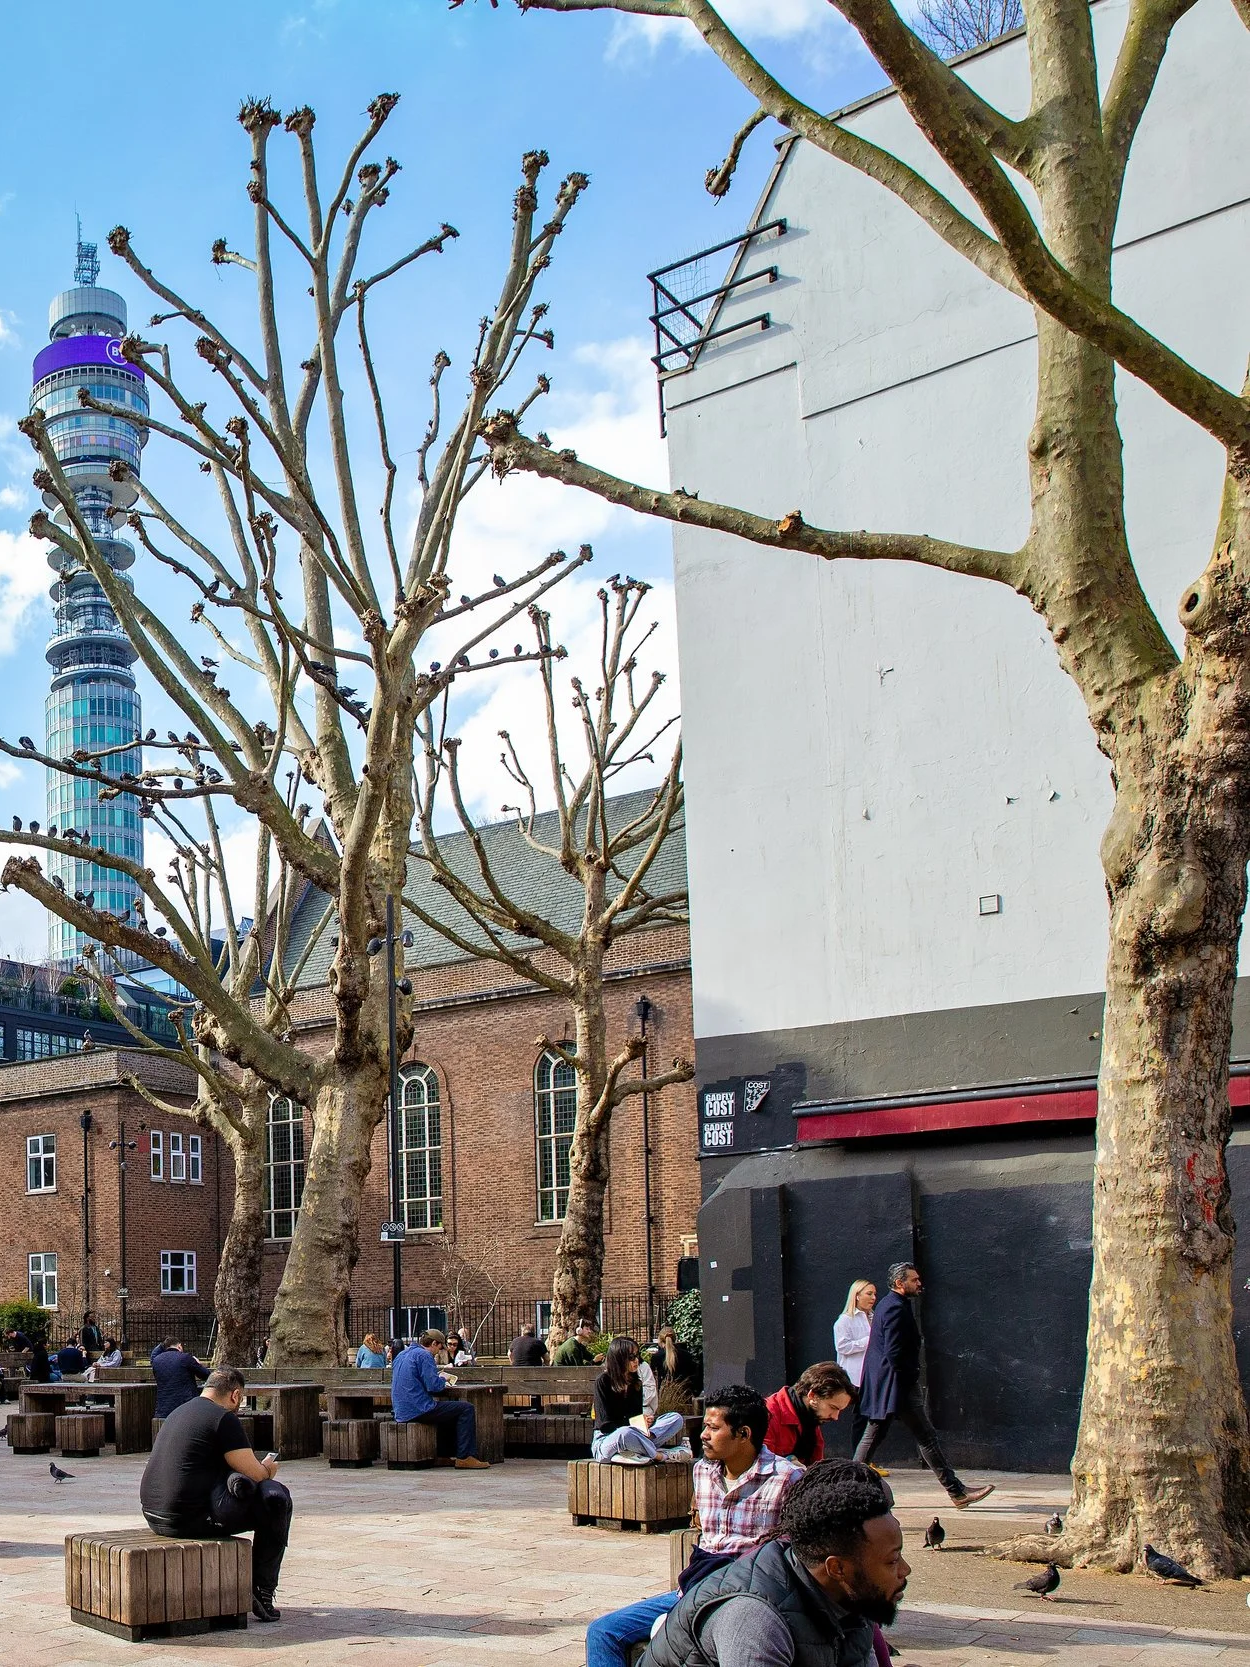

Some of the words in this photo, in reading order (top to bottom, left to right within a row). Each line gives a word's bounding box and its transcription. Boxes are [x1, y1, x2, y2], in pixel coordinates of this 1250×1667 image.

[705, 1092, 734, 1102] GADFLY
[705, 1100, 735, 1117] COST
[704, 1122, 733, 1132] GADFLY
[704, 1130, 733, 1146] COST
